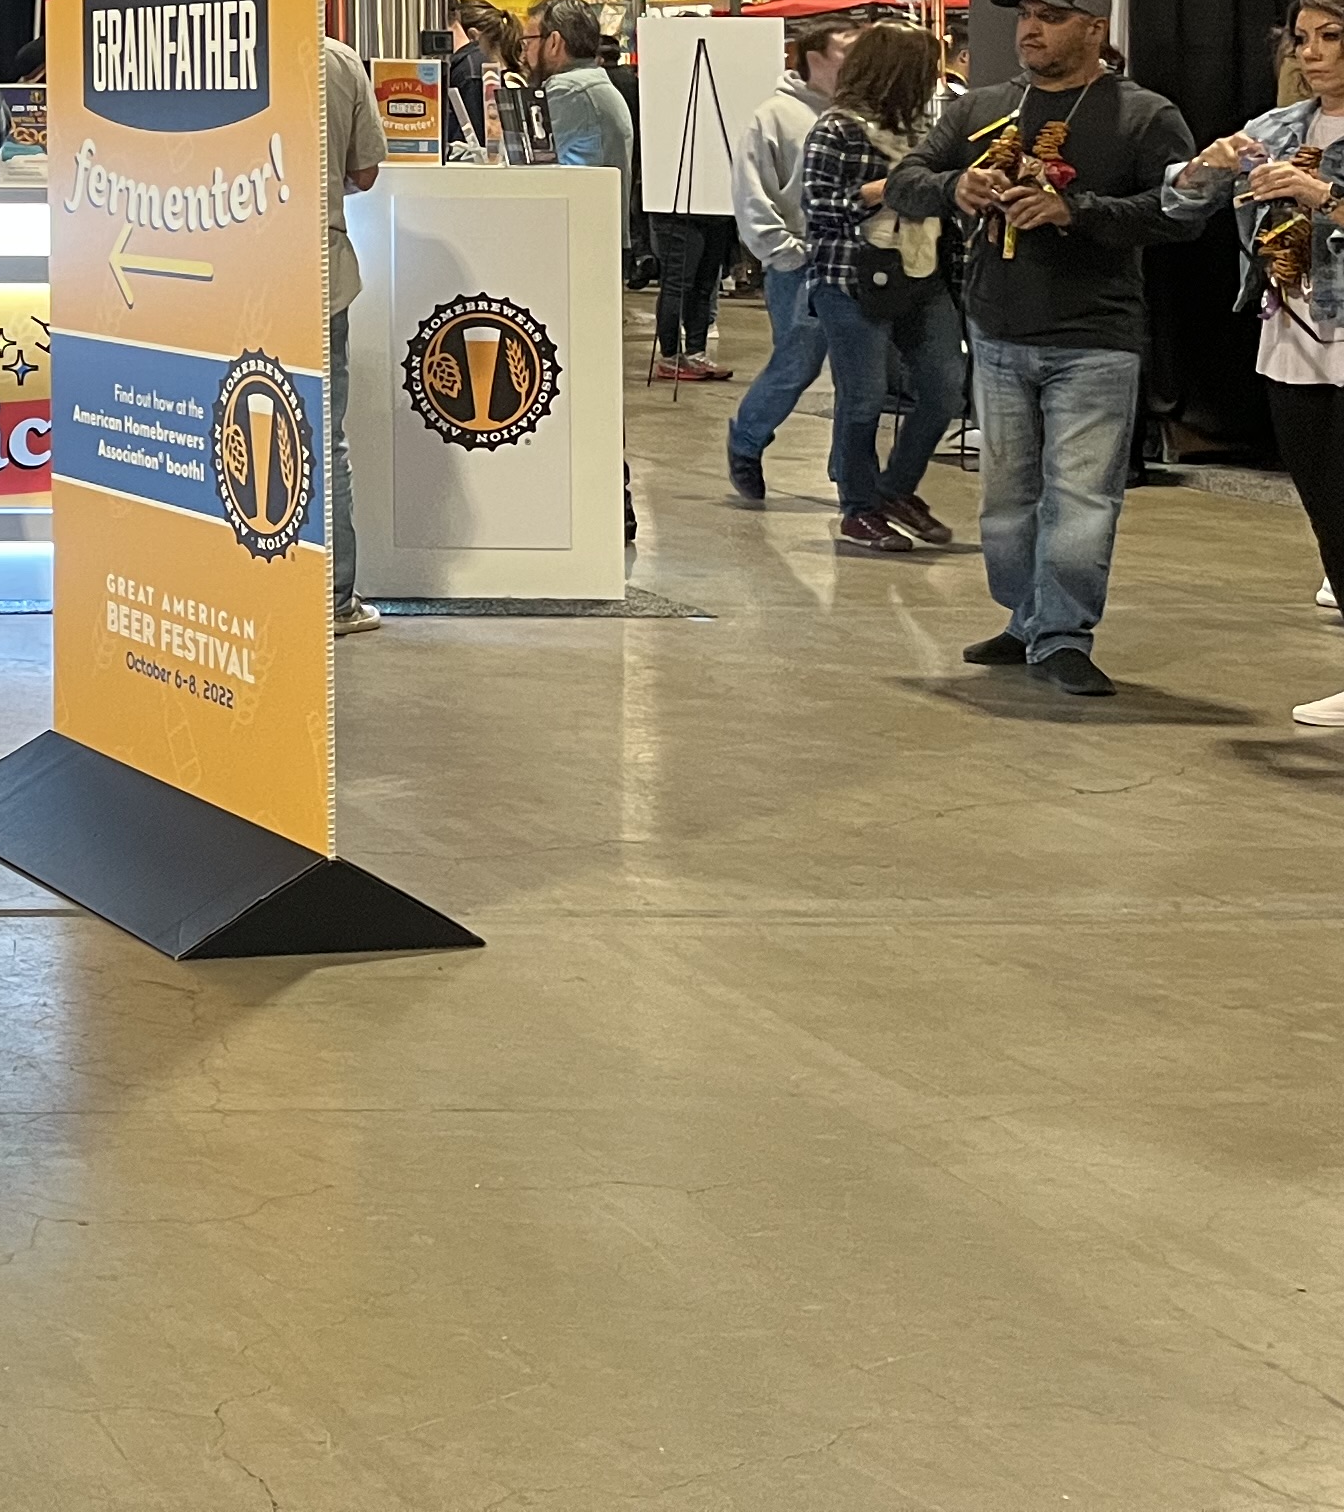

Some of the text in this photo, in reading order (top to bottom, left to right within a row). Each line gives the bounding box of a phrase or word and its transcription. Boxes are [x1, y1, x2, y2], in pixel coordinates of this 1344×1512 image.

[92, 0, 258, 92] GRAINFATHER
[64, 132, 290, 232] fermenter!
[421, 300, 542, 343] HOMEBREWERS
[114, 383, 204, 420] Find out how at the
[220, 359, 302, 422] HOMEBREWERS
[412, 354, 461, 437] AMERICAN
[476, 358, 552, 443] ASSOCIATION
[73, 404, 205, 451] American Homebrewers
[166, 454, 204, 482] booth!
[257, 445, 310, 551] ASSOCIATION
[106, 573, 255, 641] GREAT AMERICAN
[106, 600, 155, 648] BEER
[126, 651, 171, 685] October
[203, 679, 234, 710] 2022
